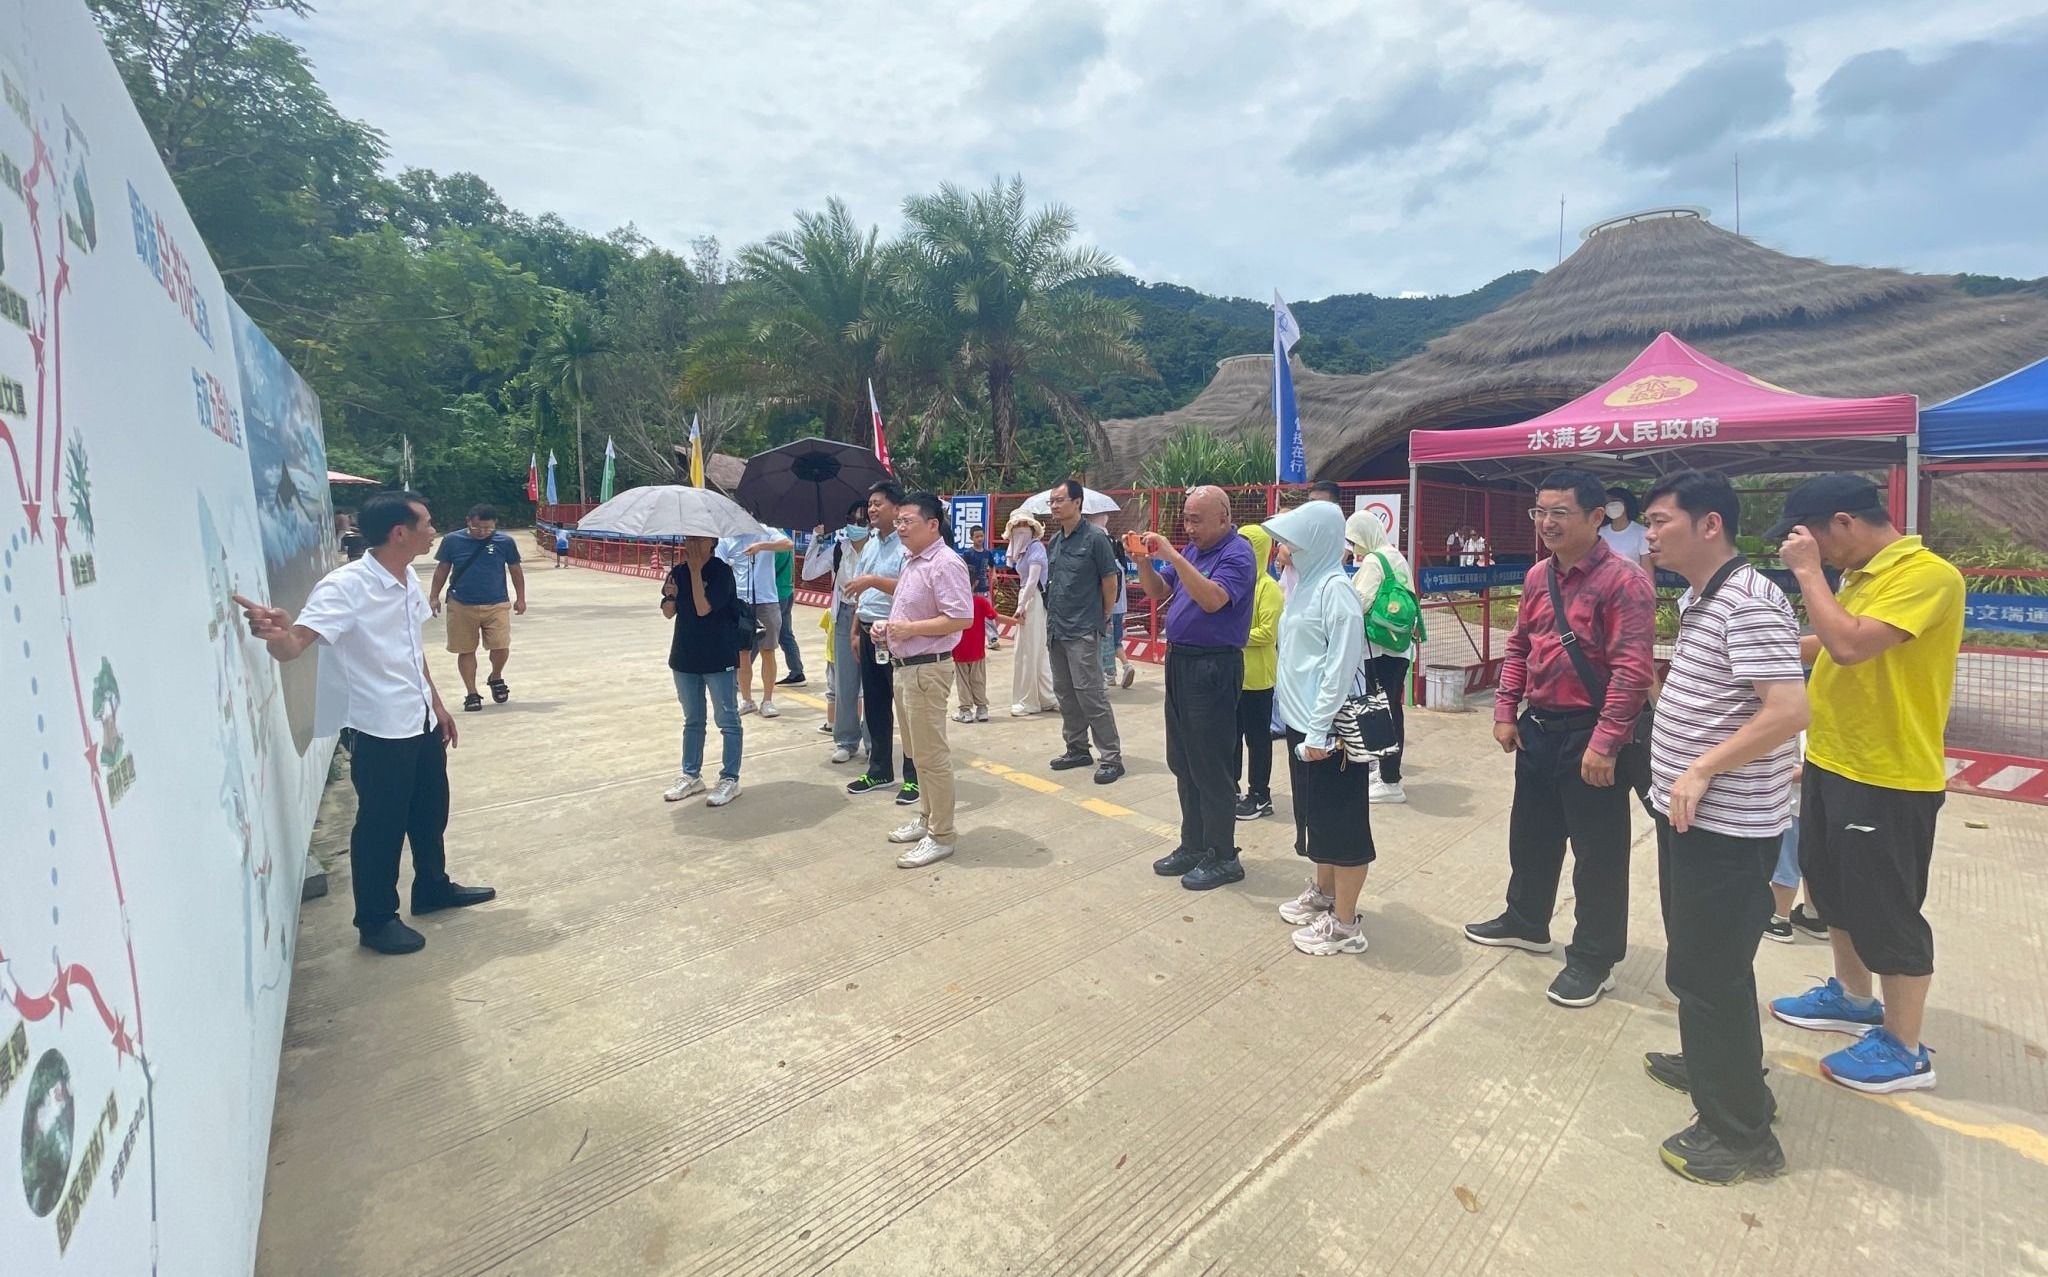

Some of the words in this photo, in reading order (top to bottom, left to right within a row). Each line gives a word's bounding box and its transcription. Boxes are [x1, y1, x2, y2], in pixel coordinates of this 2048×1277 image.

[1527, 417, 1719, 451] 水满乡人民政府
